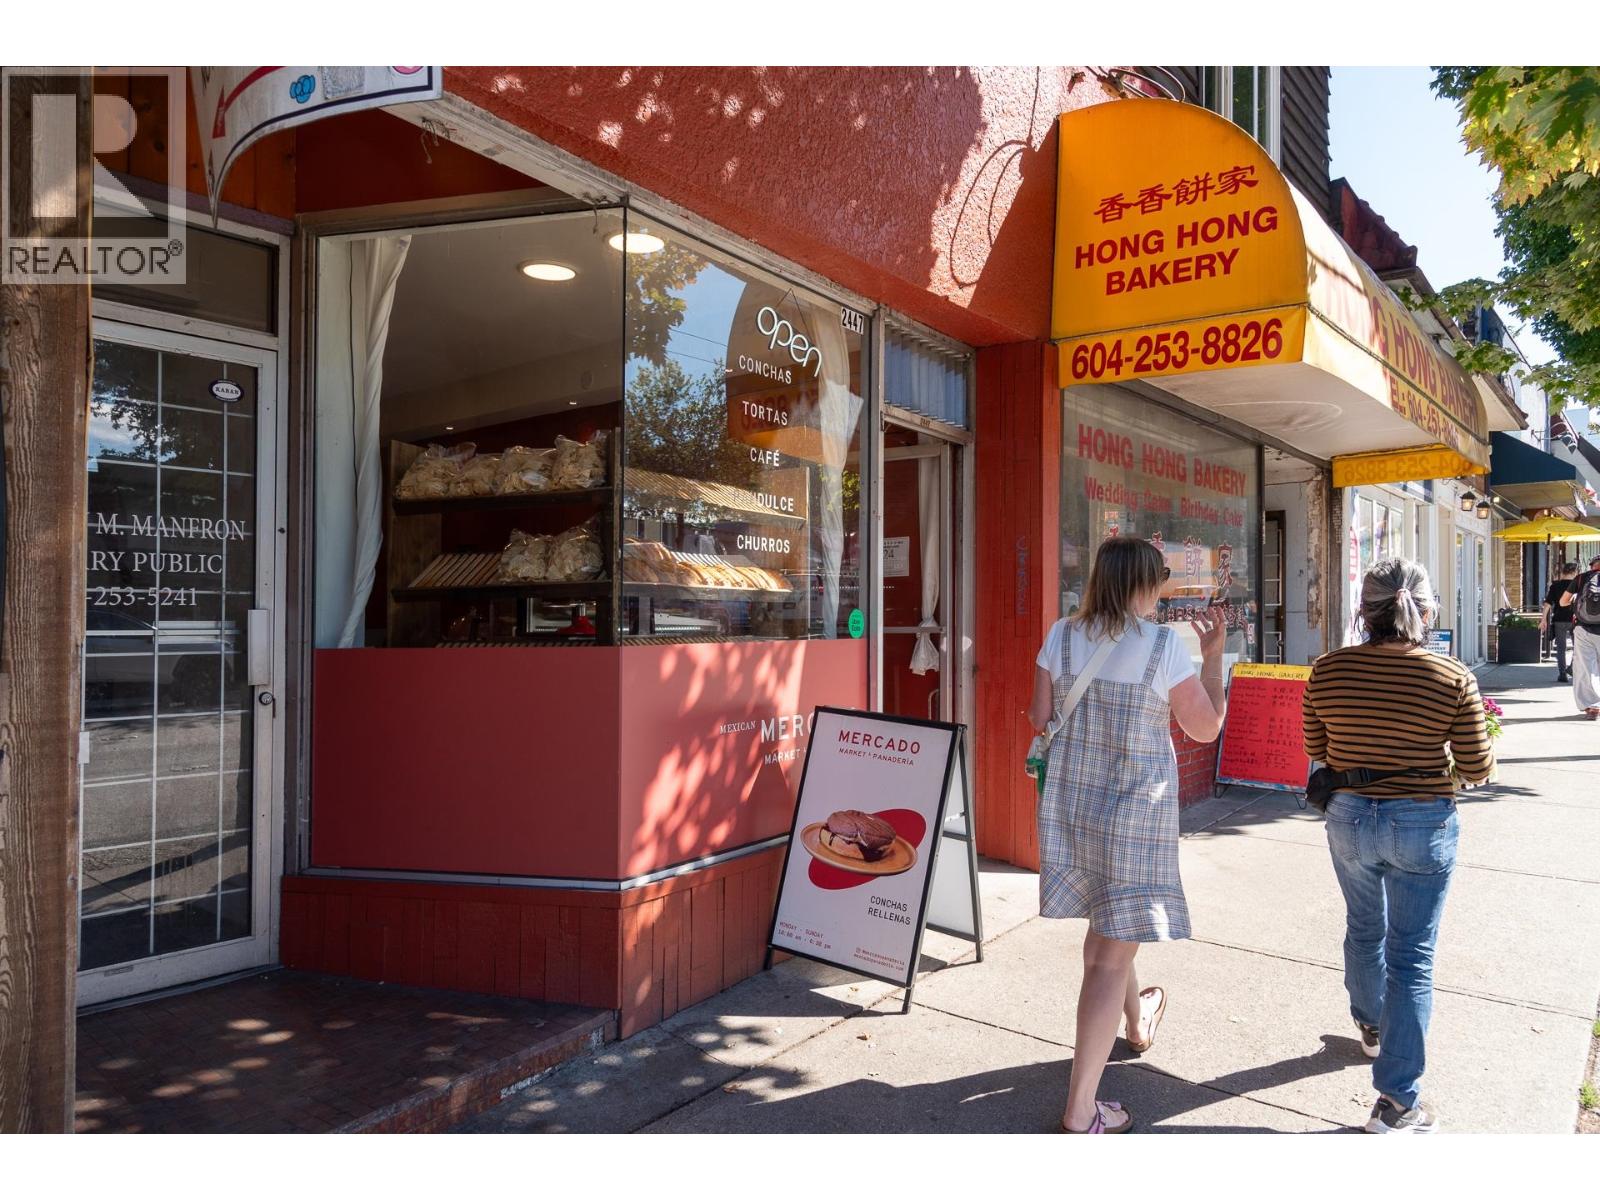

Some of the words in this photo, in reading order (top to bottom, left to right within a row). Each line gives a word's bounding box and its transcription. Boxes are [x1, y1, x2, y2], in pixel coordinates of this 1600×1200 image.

[1094, 165, 1259, 224] 香香餅家
[1075, 229, 1165, 269] HONG
[1177, 206, 1278, 249] HONG
[1106, 248, 1240, 296] BAKERY
[842, 308, 864, 334] 2447
[1071, 318, 1283, 380] 604-253-8826
[738, 354, 792, 385] CONCHAS
[742, 400, 788, 426] TORTAS
[750, 447, 780, 467] CAFÉ
[1078, 423, 1134, 471] HONG
[1142, 443, 1187, 483] HONG
[1194, 457, 1246, 497] BAKERY
[757, 492, 794, 512] DULCE
[1084, 475, 1137, 512] Wedding
[95, 512, 124, 536] M.
[131, 514, 246, 542] MANFRON
[737, 534, 791, 554] CHURROS
[133, 552, 223, 574] PUBLIC
[719, 720, 756, 735] MEXICAN
[838, 730, 920, 755] MERCADO
[838, 747, 866, 757] MARKET
[764, 748, 800, 765] MARKET
[868, 906, 911, 926] RELLENAS
[870, 895, 908, 912] CONCHAS
